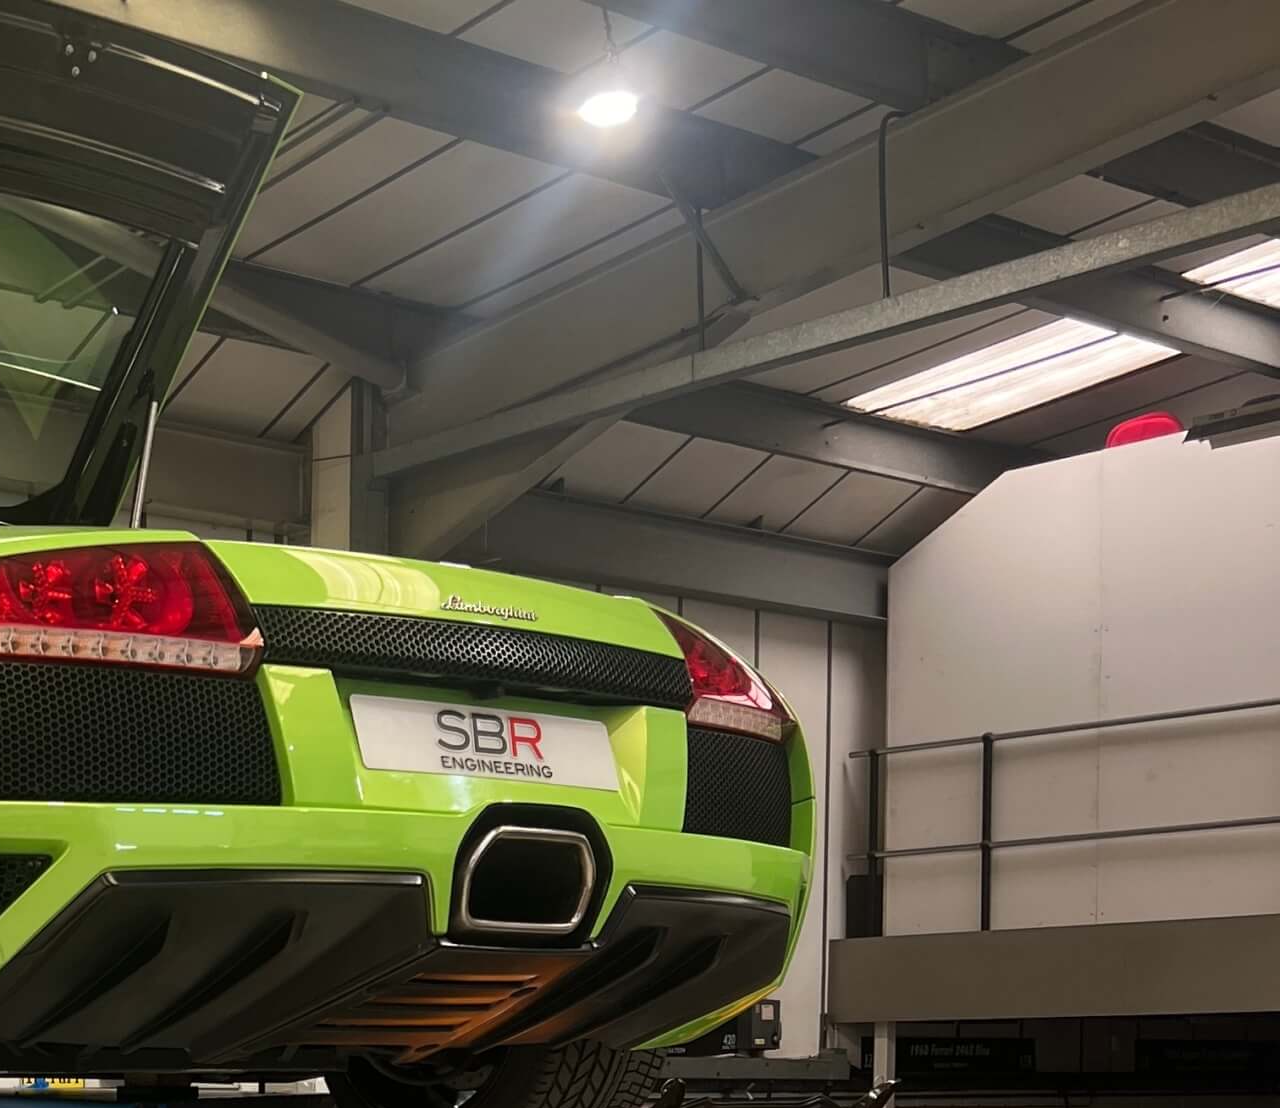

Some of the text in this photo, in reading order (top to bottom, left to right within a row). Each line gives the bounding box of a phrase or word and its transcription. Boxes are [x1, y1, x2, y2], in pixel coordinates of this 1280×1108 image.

[440, 594, 538, 621] Lamborghini
[437, 709, 544, 760] SBR
[440, 755, 554, 779] ENGINEERING
